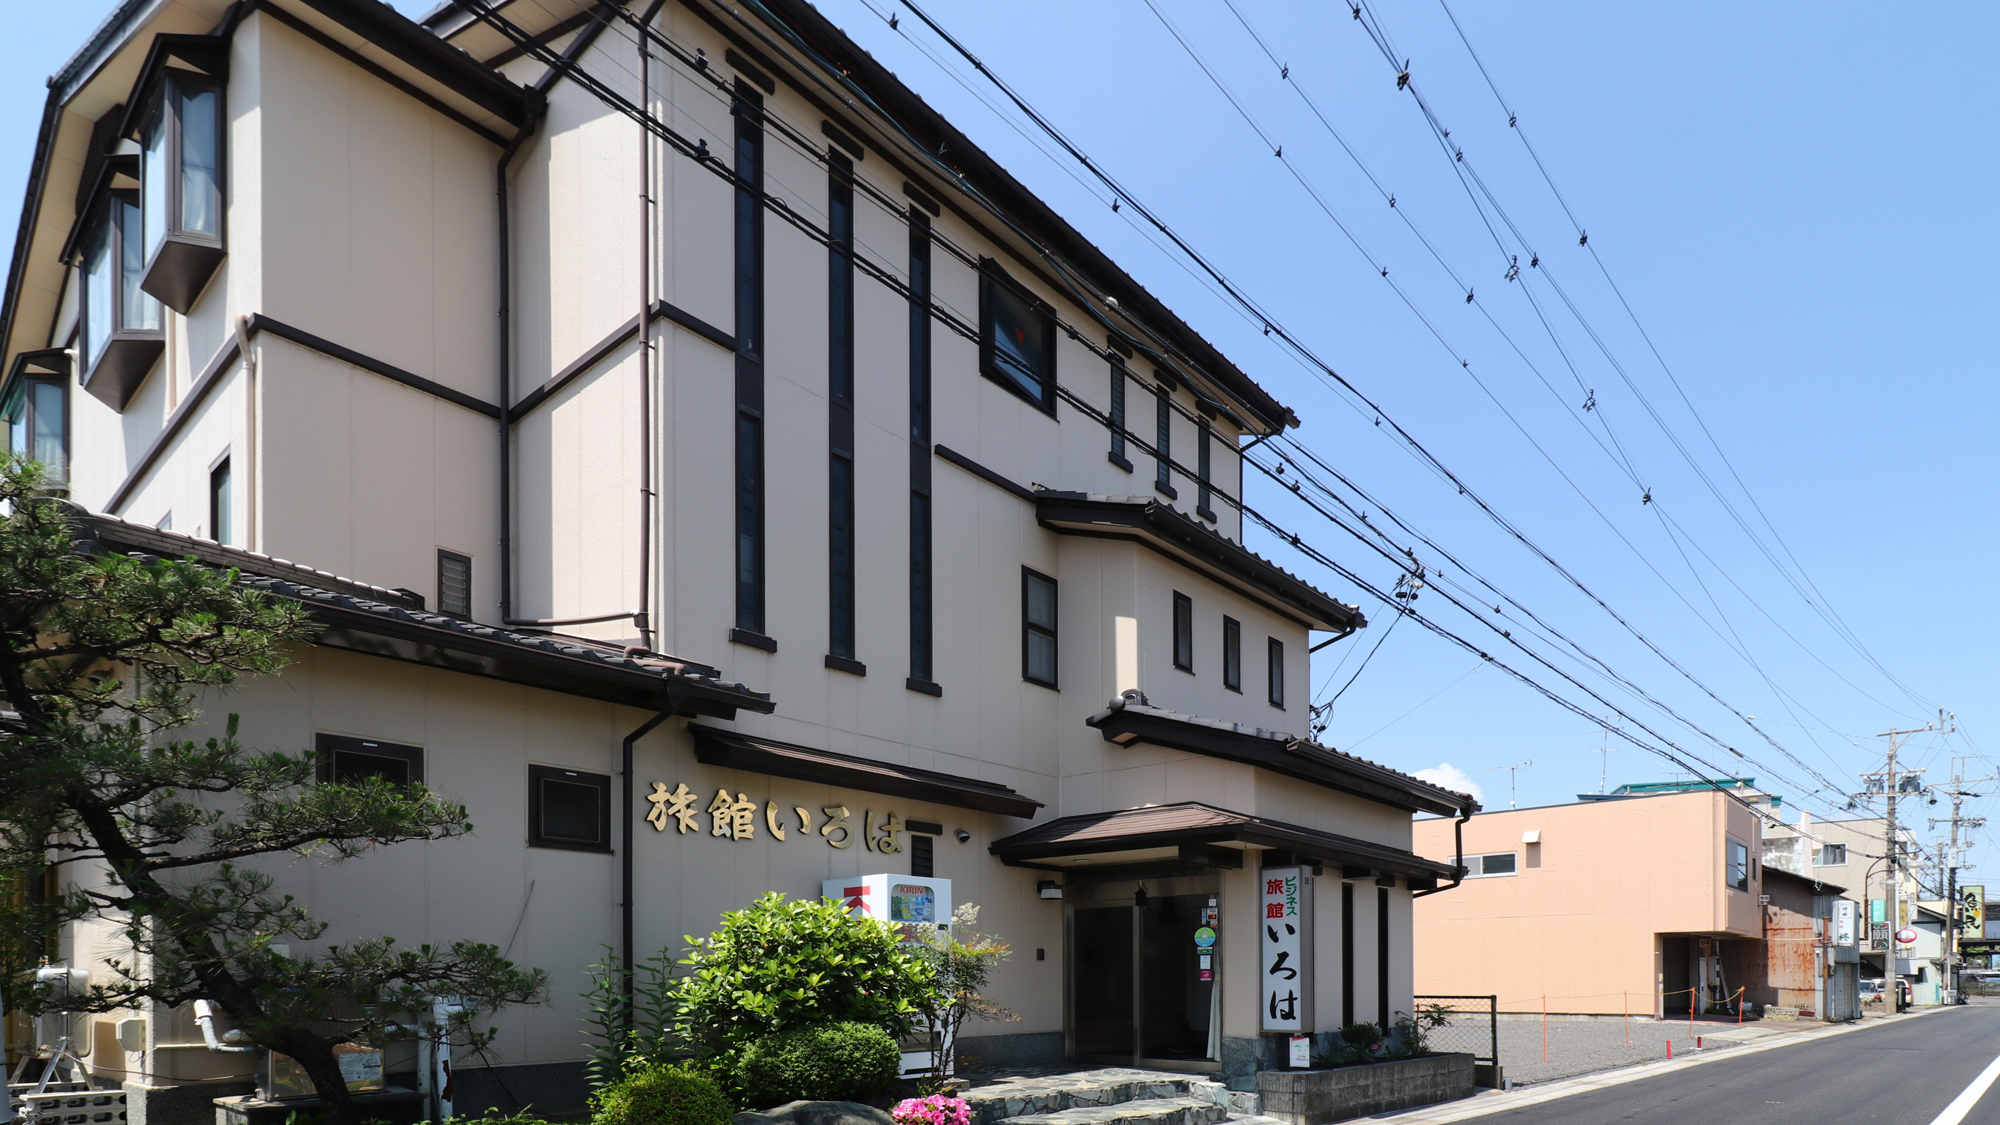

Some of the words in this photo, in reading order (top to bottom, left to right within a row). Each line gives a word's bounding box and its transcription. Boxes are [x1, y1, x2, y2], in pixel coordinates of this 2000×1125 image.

[646, 781, 904, 854] 旅館いろは
[900, 885, 924, 895] KIRIN
[1266, 879, 1284, 919] 旅館
[1285, 875, 1298, 917] ビジネス
[1267, 923, 1298, 1021] いろは
